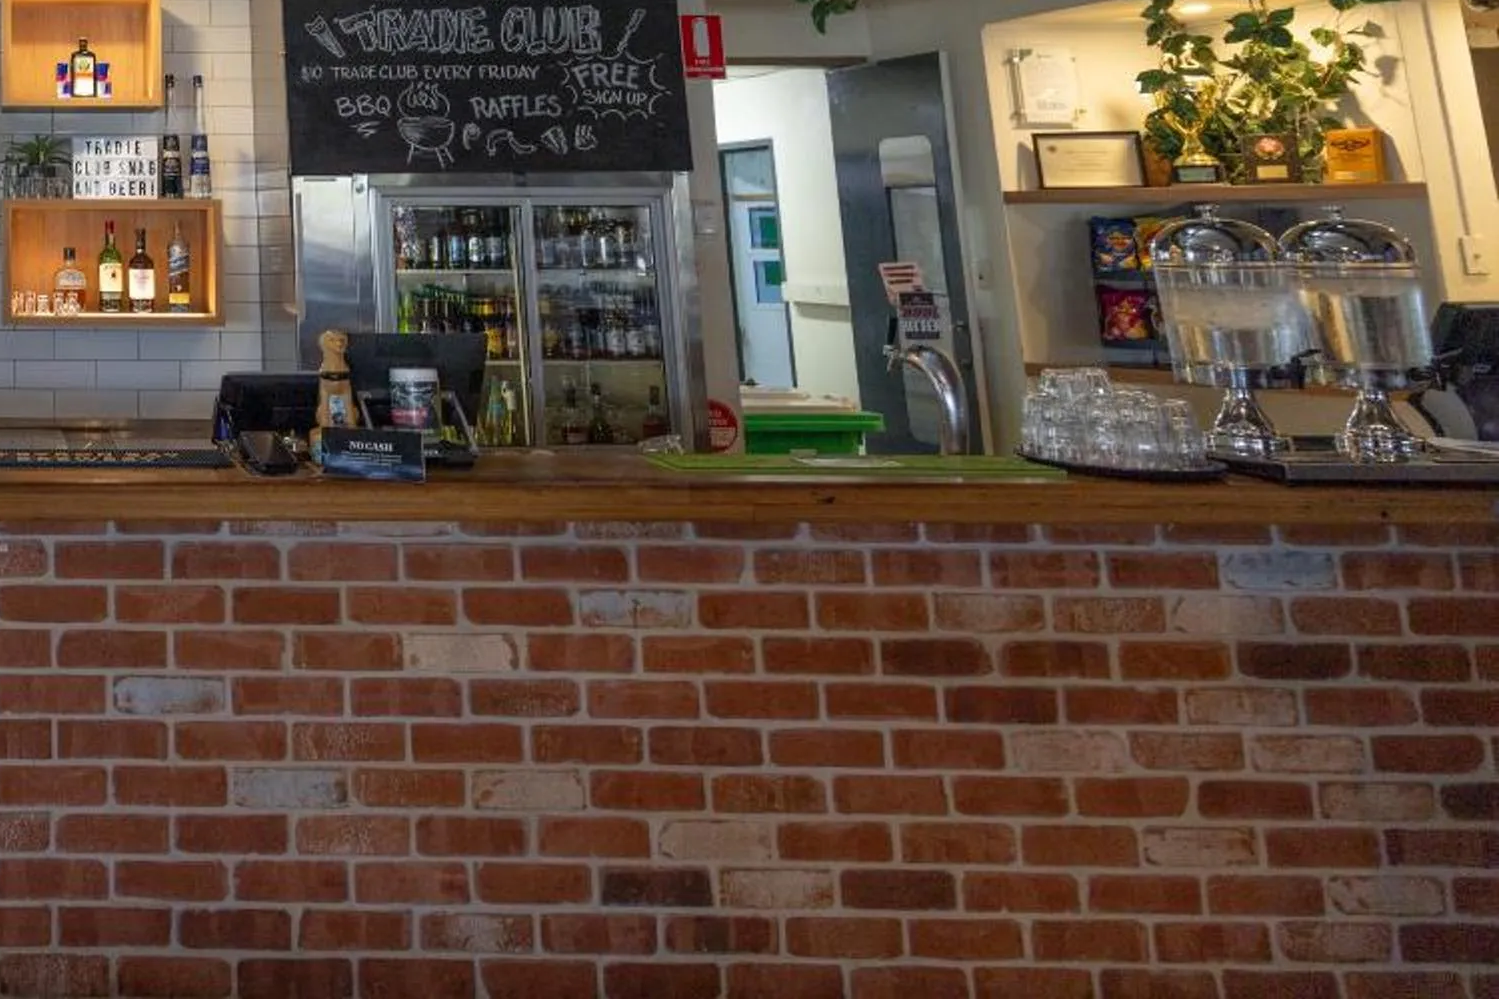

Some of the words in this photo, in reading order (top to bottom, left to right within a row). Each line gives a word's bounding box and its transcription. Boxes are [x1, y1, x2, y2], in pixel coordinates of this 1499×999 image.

[501, 5, 602, 55] CLUB
[379, 64, 418, 79] CLUB
[423, 64, 472, 80] EVERY
[478, 64, 540, 80] FRIDAY
[571, 62, 639, 89] FREE
[582, 89, 622, 104] SIGN
[626, 91, 648, 105] UP
[335, 94, 392, 117] BBQ
[469, 93, 563, 119] RAFFLES
[85, 140, 142, 155] TRADIE
[119, 160, 156, 175] SNAG
[109, 180, 154, 196] BEER!
[348, 440, 364, 450] NO
[364, 441, 394, 452] CASH
